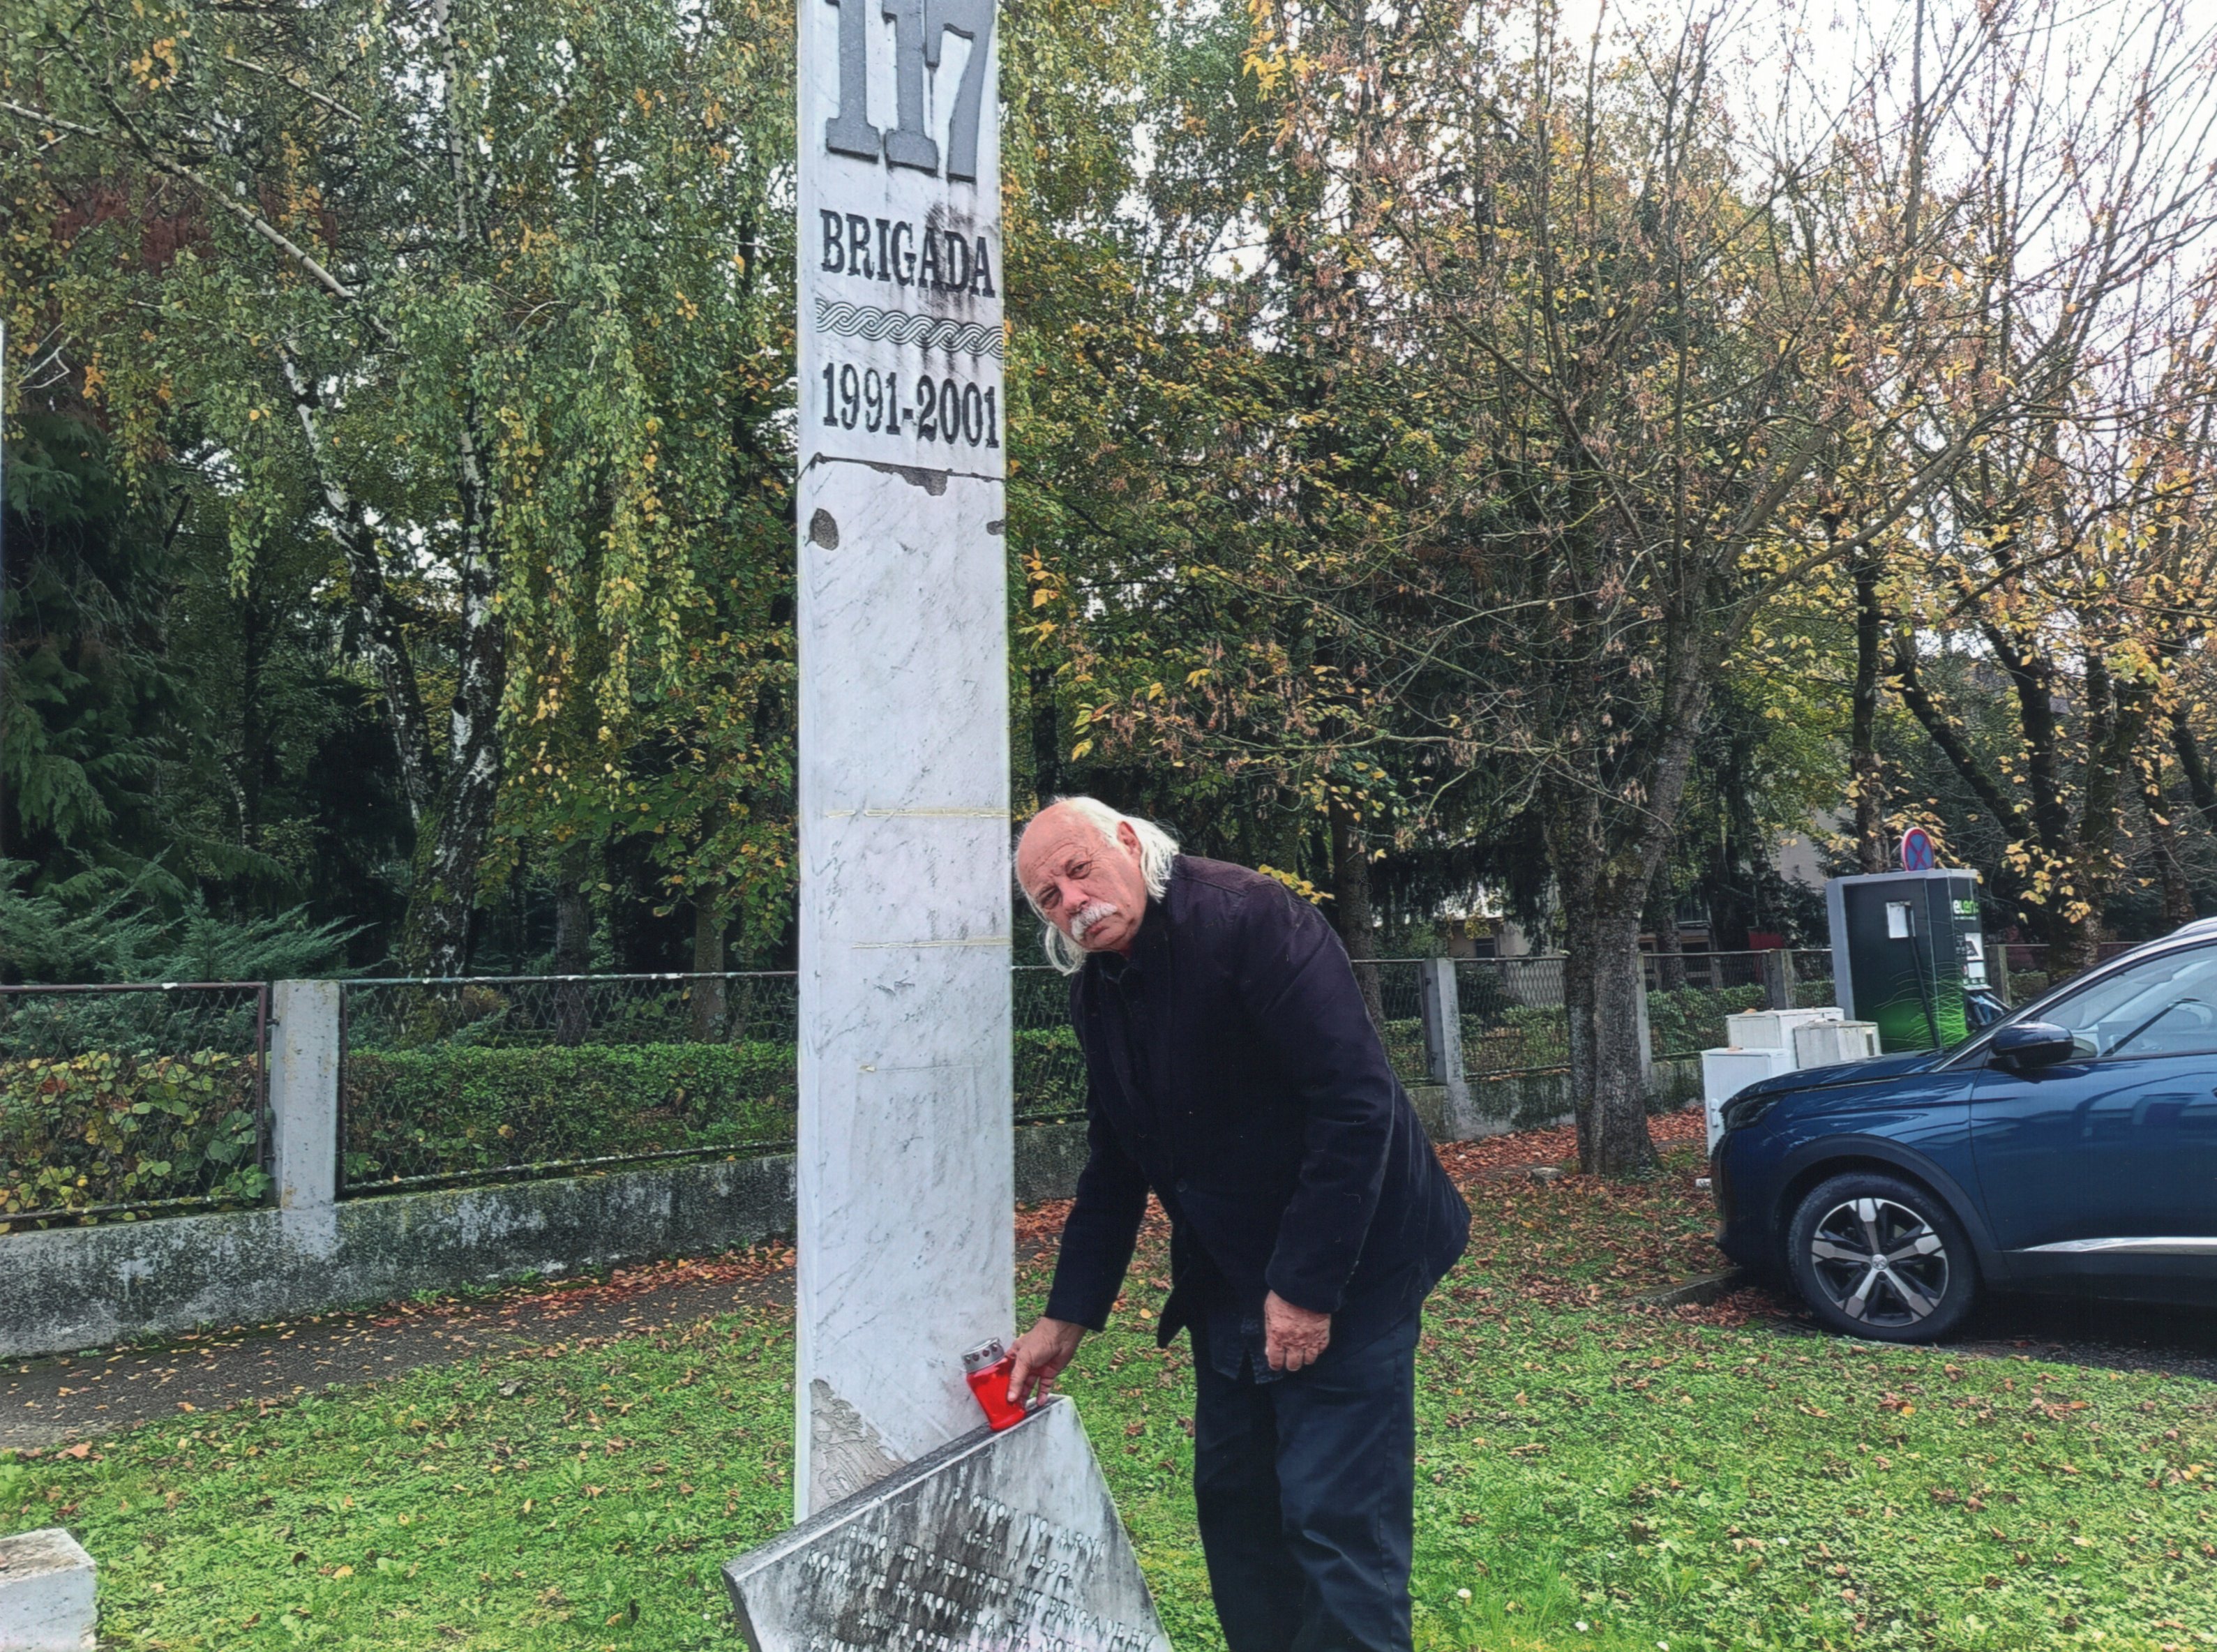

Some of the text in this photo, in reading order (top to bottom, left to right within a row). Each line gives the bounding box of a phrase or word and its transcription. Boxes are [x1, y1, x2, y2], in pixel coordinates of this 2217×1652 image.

[824, 0, 996, 183] 117
[820, 209, 995, 298] BRIGADA
[822, 362, 999, 448] 1991-2001
[1030, 1552, 1070, 1579] 1992
[1046, 1596, 1125, 1637] BRIGADE
